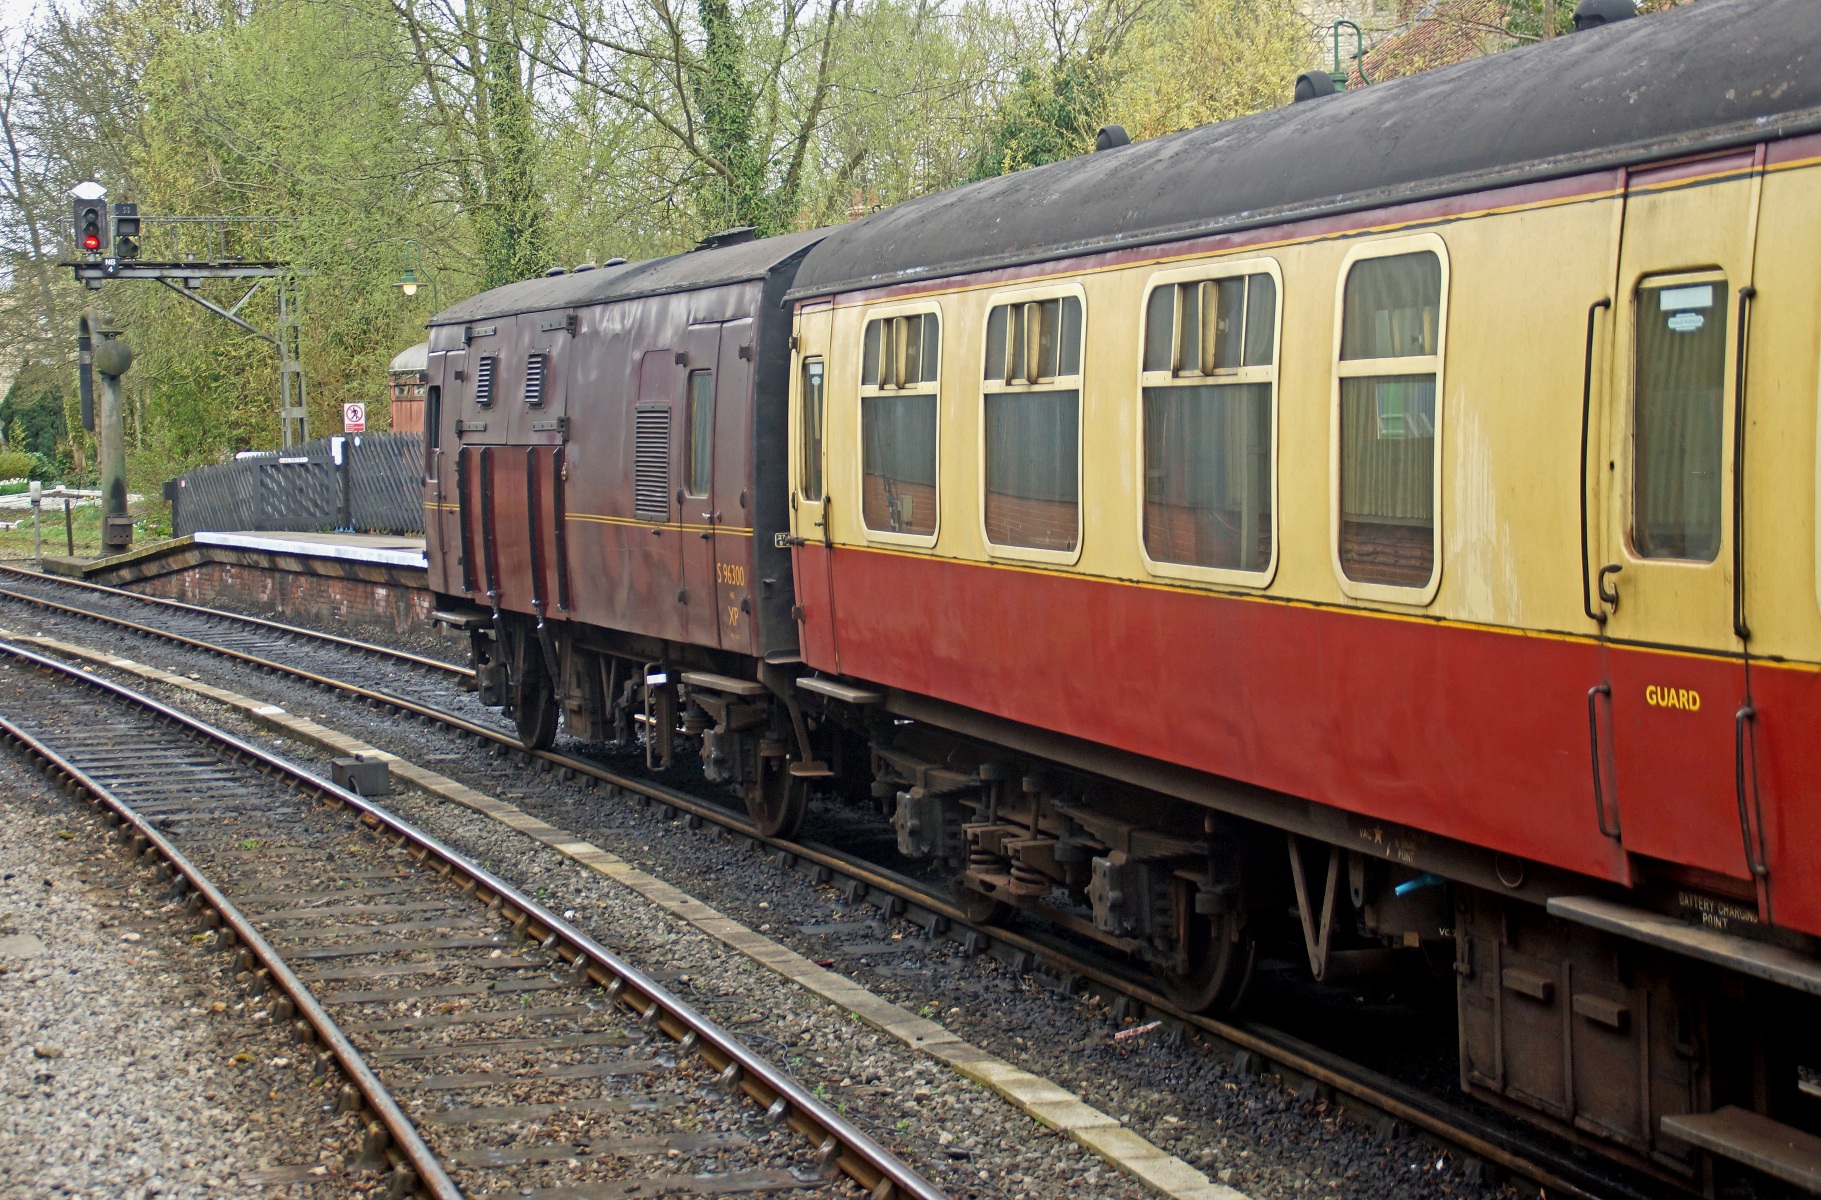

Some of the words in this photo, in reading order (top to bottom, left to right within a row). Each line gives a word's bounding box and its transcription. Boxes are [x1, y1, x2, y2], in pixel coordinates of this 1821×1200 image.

[716, 562, 722, 583] S
[722, 563, 745, 587] 96300
[727, 605, 739, 627] XP
[1645, 684, 1701, 712] GUARD
[1678, 891, 1714, 913] BATTERY
[1717, 902, 1758, 923] CHARGING
[1702, 912, 1728, 928] POINT
